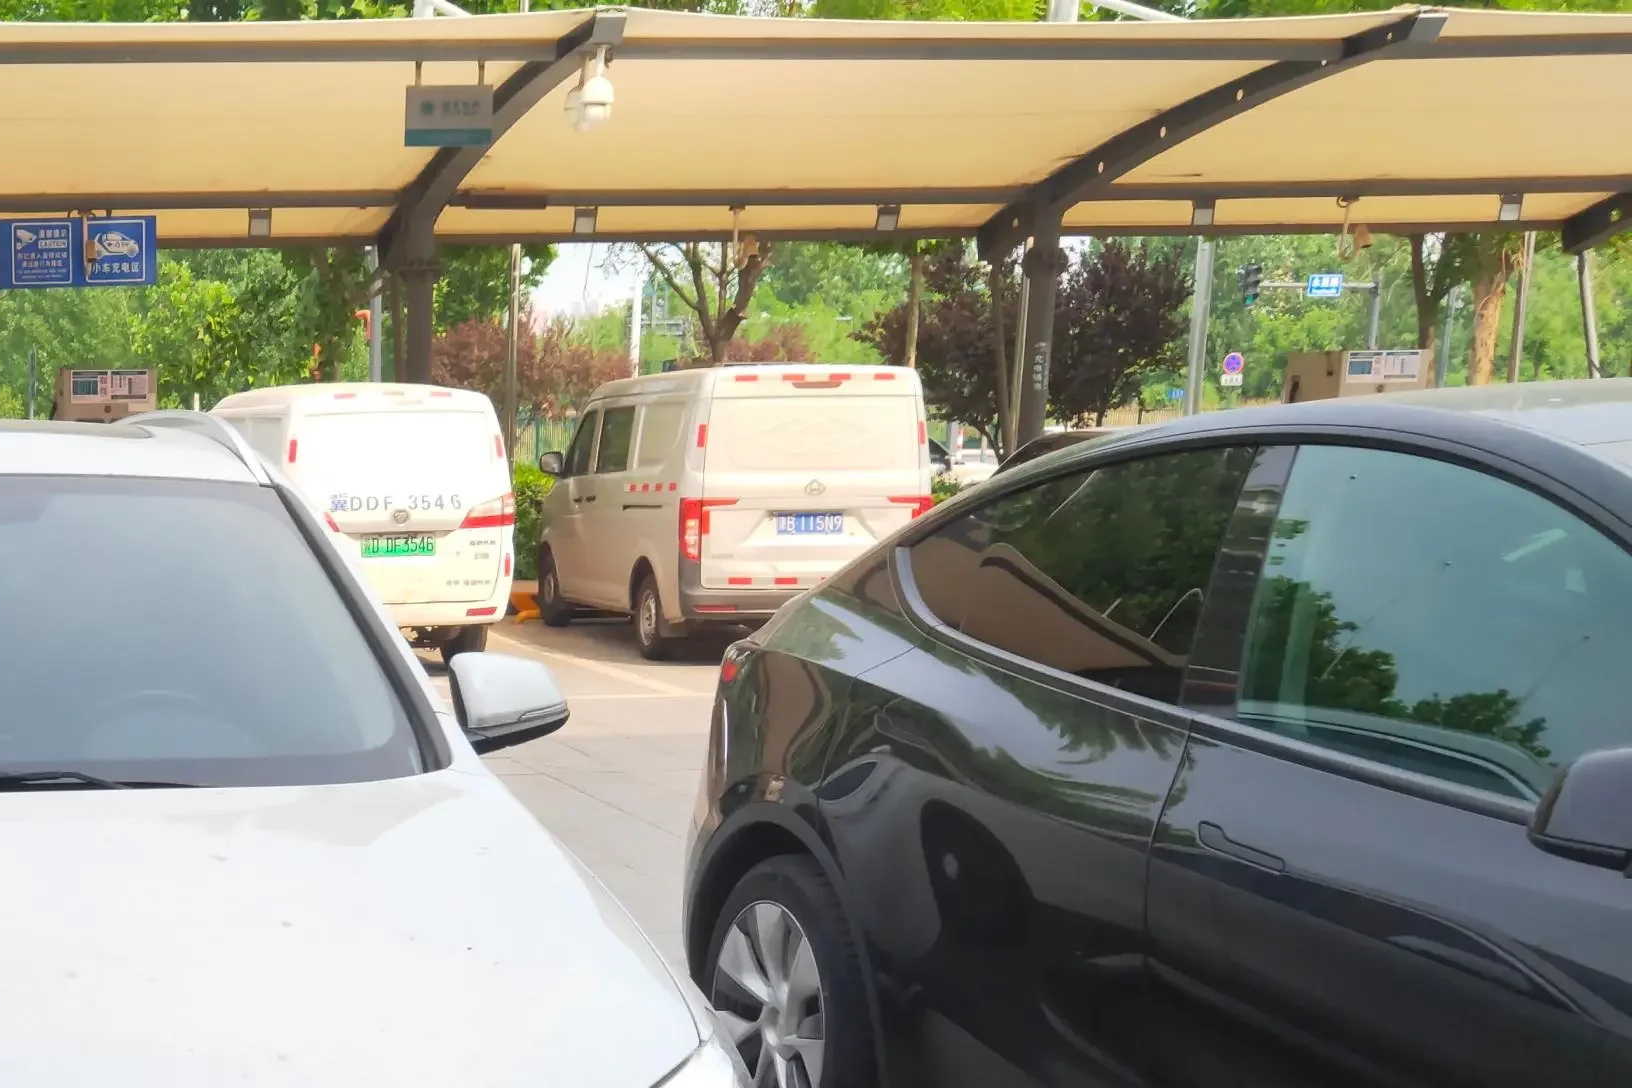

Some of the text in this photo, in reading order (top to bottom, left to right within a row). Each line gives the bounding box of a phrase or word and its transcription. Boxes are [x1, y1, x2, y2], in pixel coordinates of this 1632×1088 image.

[93, 262, 140, 274] 小车充电区
[408, 494, 462, 510] 3546
